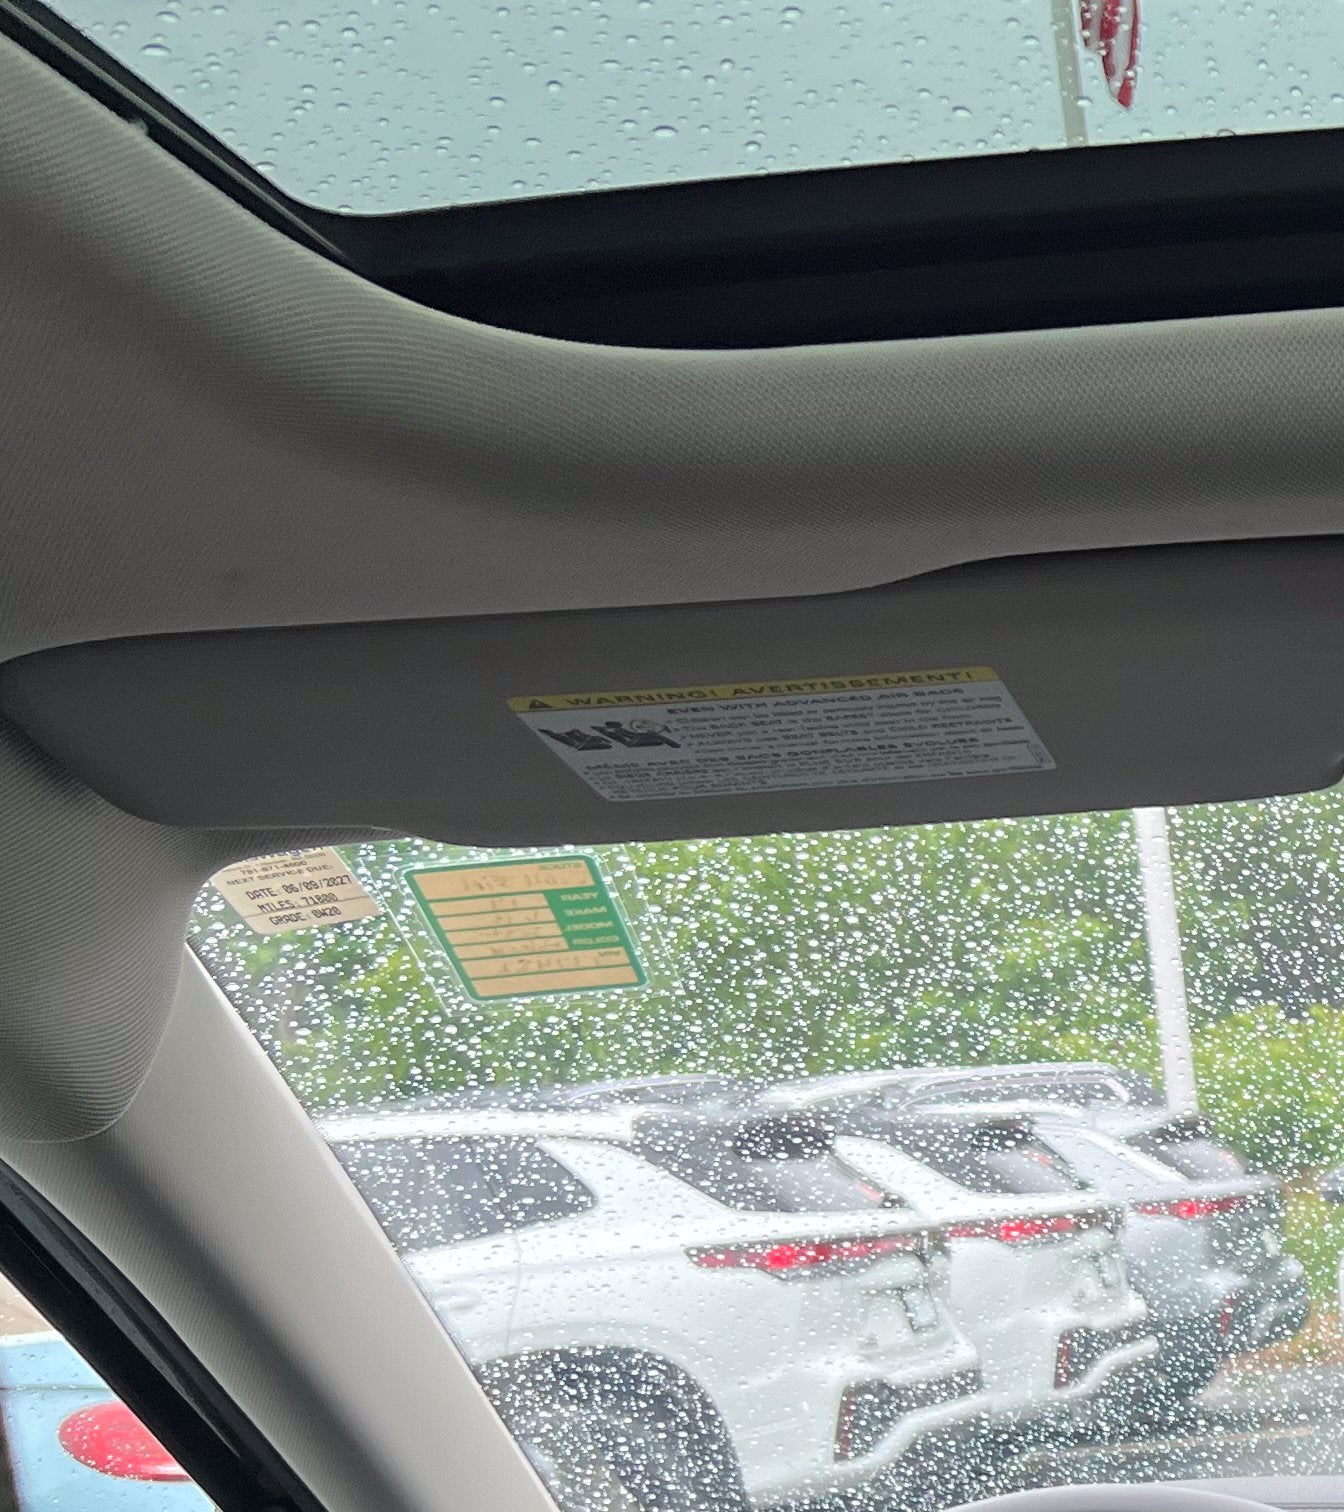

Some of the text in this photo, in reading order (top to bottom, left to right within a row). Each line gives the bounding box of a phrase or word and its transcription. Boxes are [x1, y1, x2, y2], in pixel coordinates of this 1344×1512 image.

[566, 670, 973, 706] WARNING! AVERTISSEMENT!
[226, 876, 255, 886] NEXT
[257, 868, 305, 881] SERVICE
